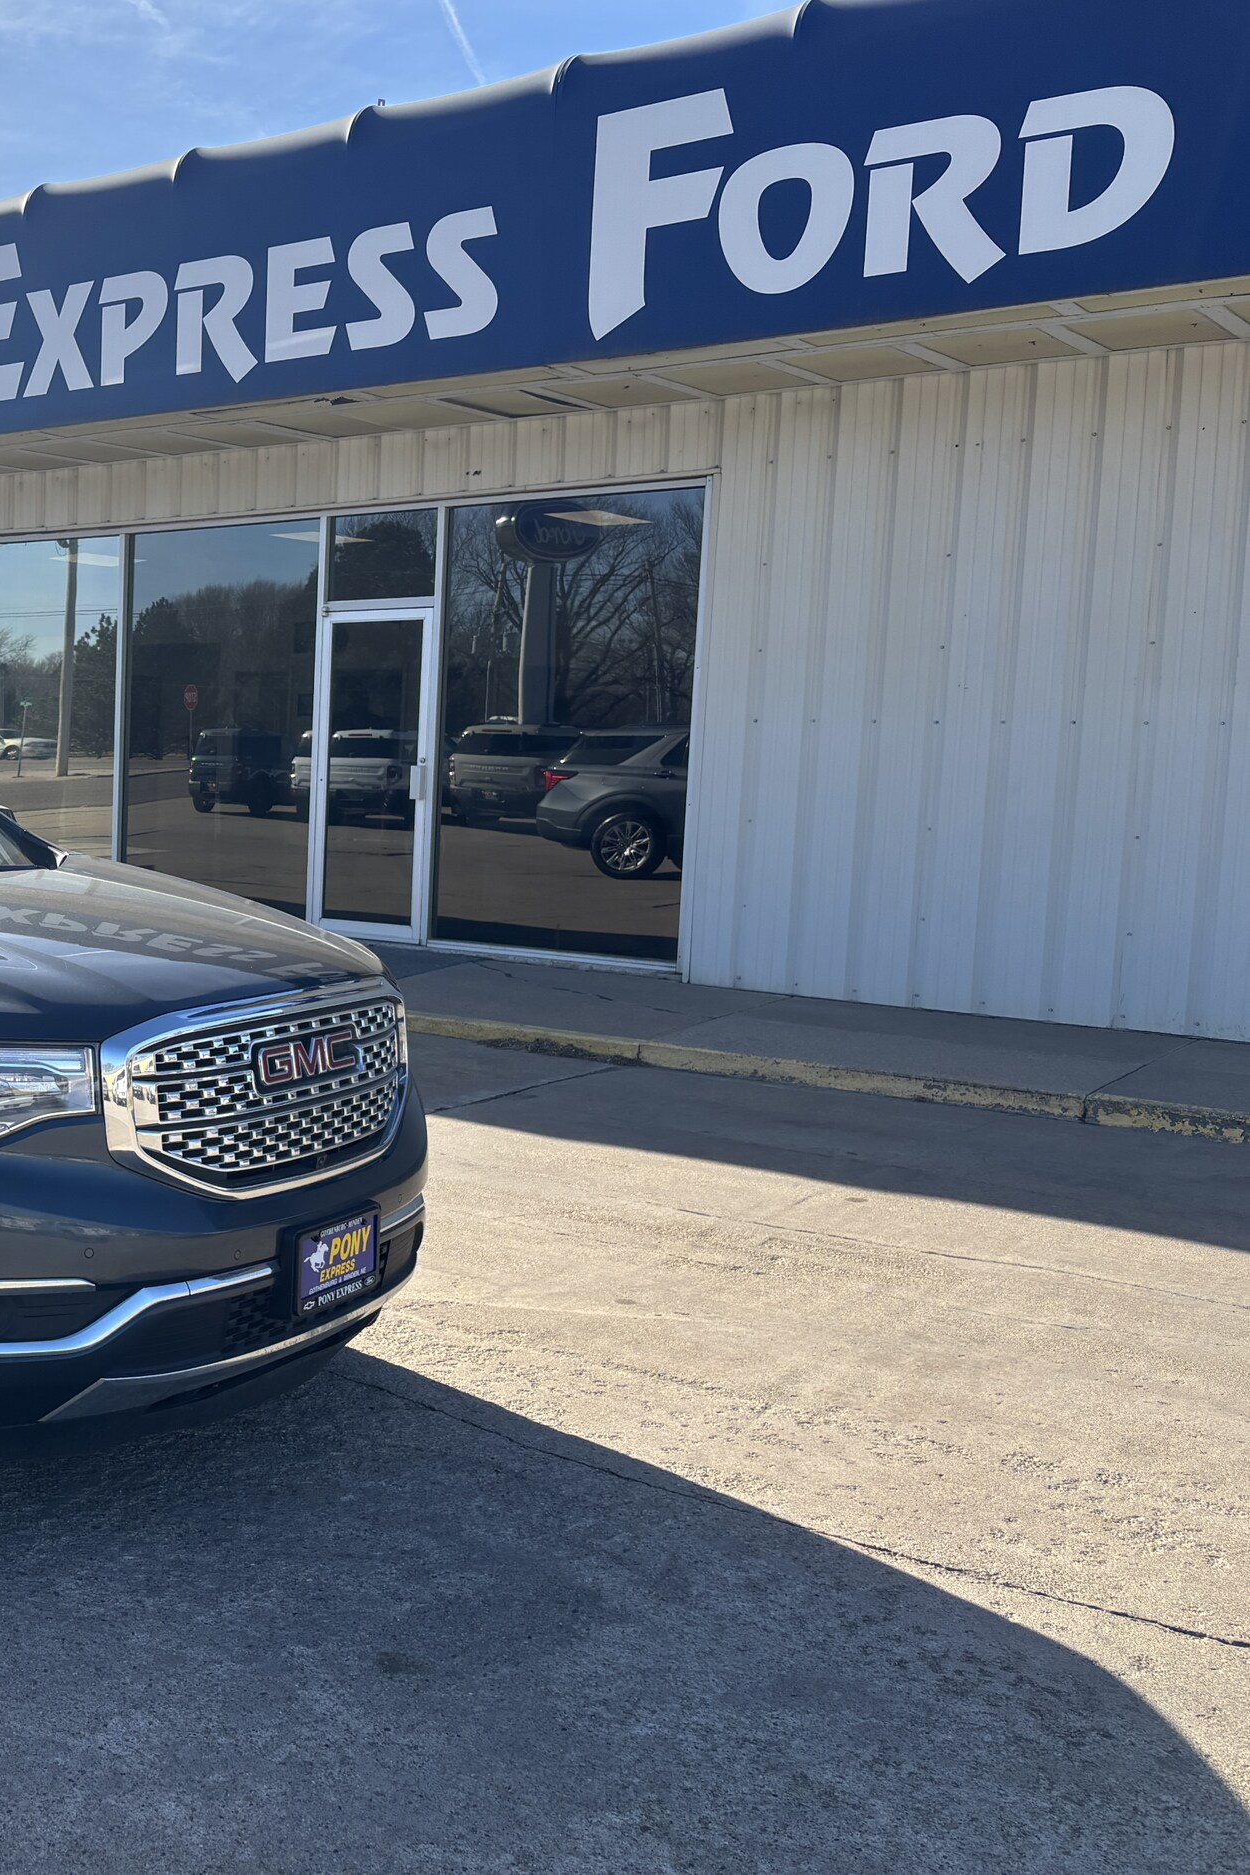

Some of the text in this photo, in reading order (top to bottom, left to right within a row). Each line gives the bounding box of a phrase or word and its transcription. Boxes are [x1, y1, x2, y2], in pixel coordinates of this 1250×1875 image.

[589, 85, 1176, 342] FORD
[261, 1029, 357, 1085] GMC
[329, 1224, 372, 1265] PONY
[319, 1258, 356, 1283] EXPRESS
[318, 1290, 335, 1306] PONY
[336, 1279, 363, 1299] EXPRESS
